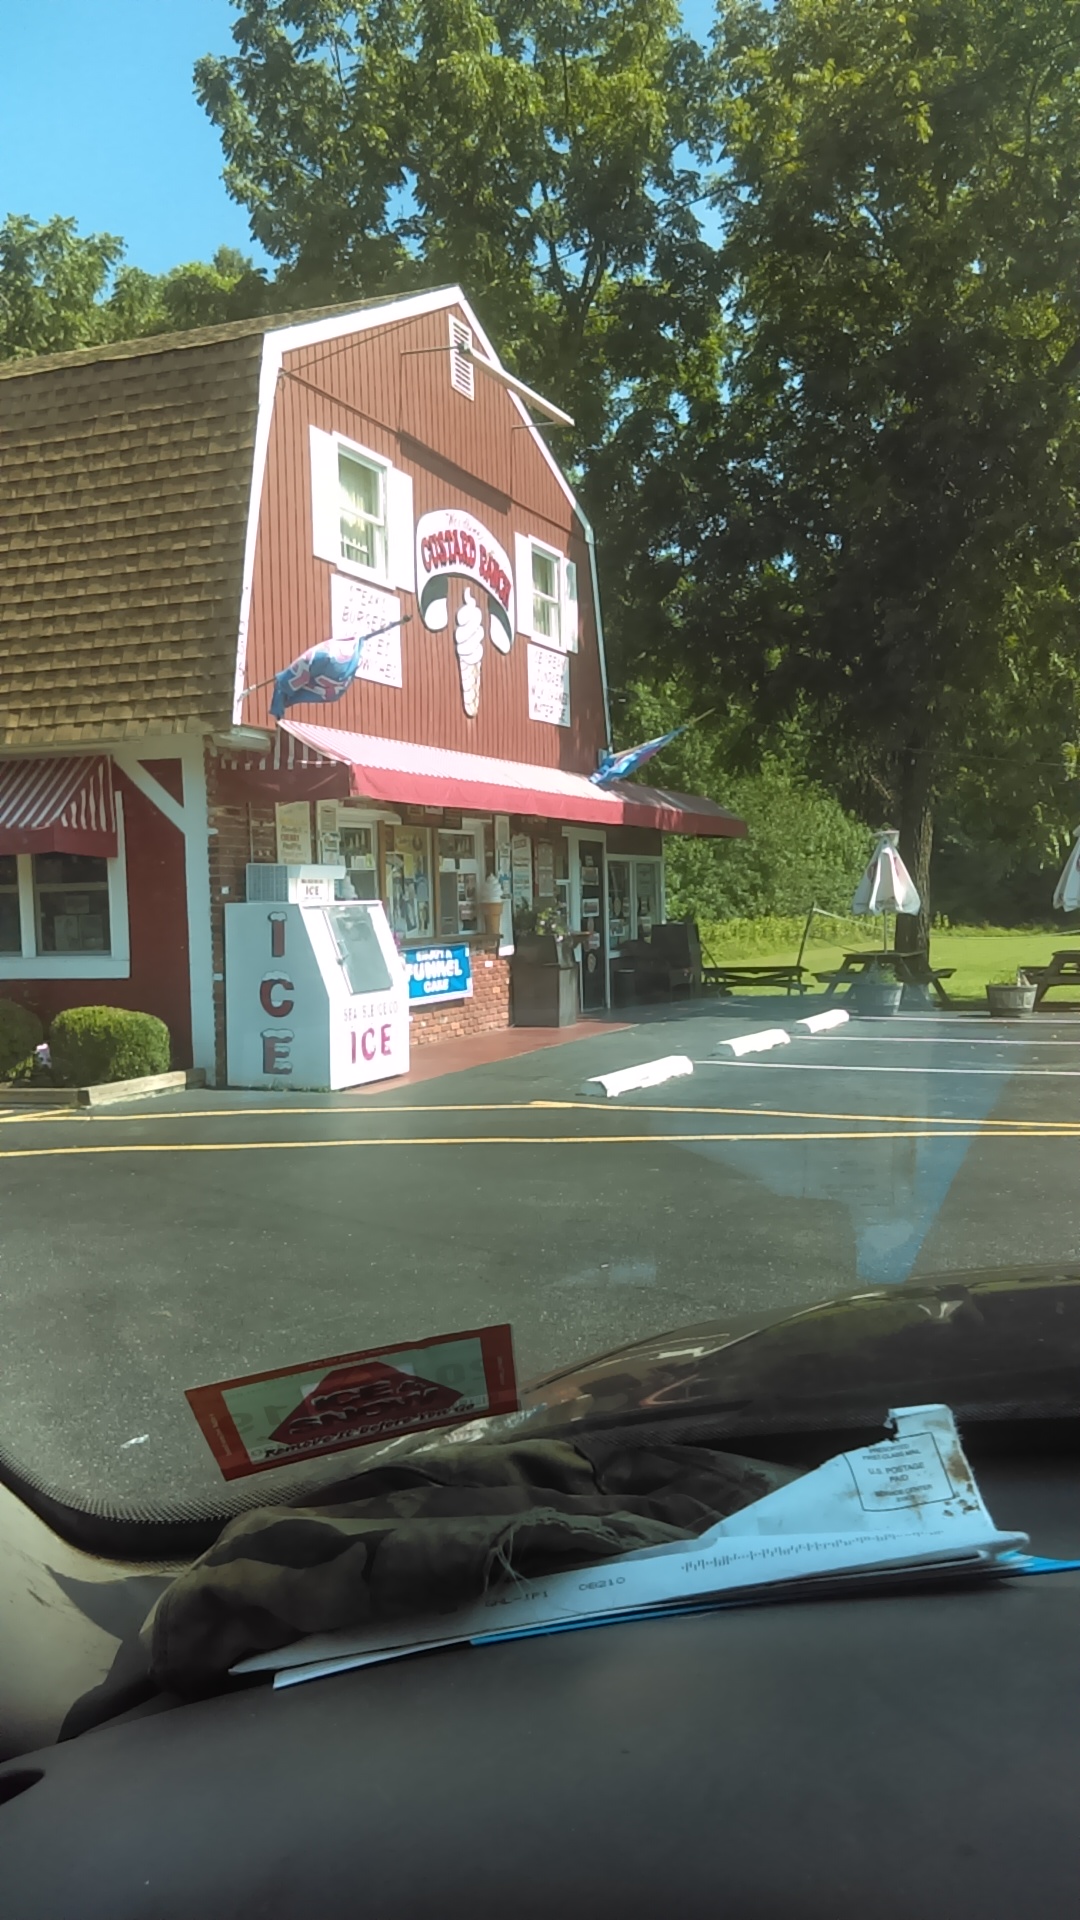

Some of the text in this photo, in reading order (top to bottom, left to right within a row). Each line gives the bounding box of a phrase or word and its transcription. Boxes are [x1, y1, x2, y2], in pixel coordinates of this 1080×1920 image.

[421, 529, 512, 612] CUSTARD RANCH
[305, 885, 319, 896] ICE
[423, 978, 450, 994] CAKE
[343, 1007, 357, 1022] SEA
[359, 1004, 374, 1018] SLE
[351, 1023, 392, 1064] ICE
[885, 1461, 925, 1475] POSTAGE
[889, 1474, 909, 1483] PAID
